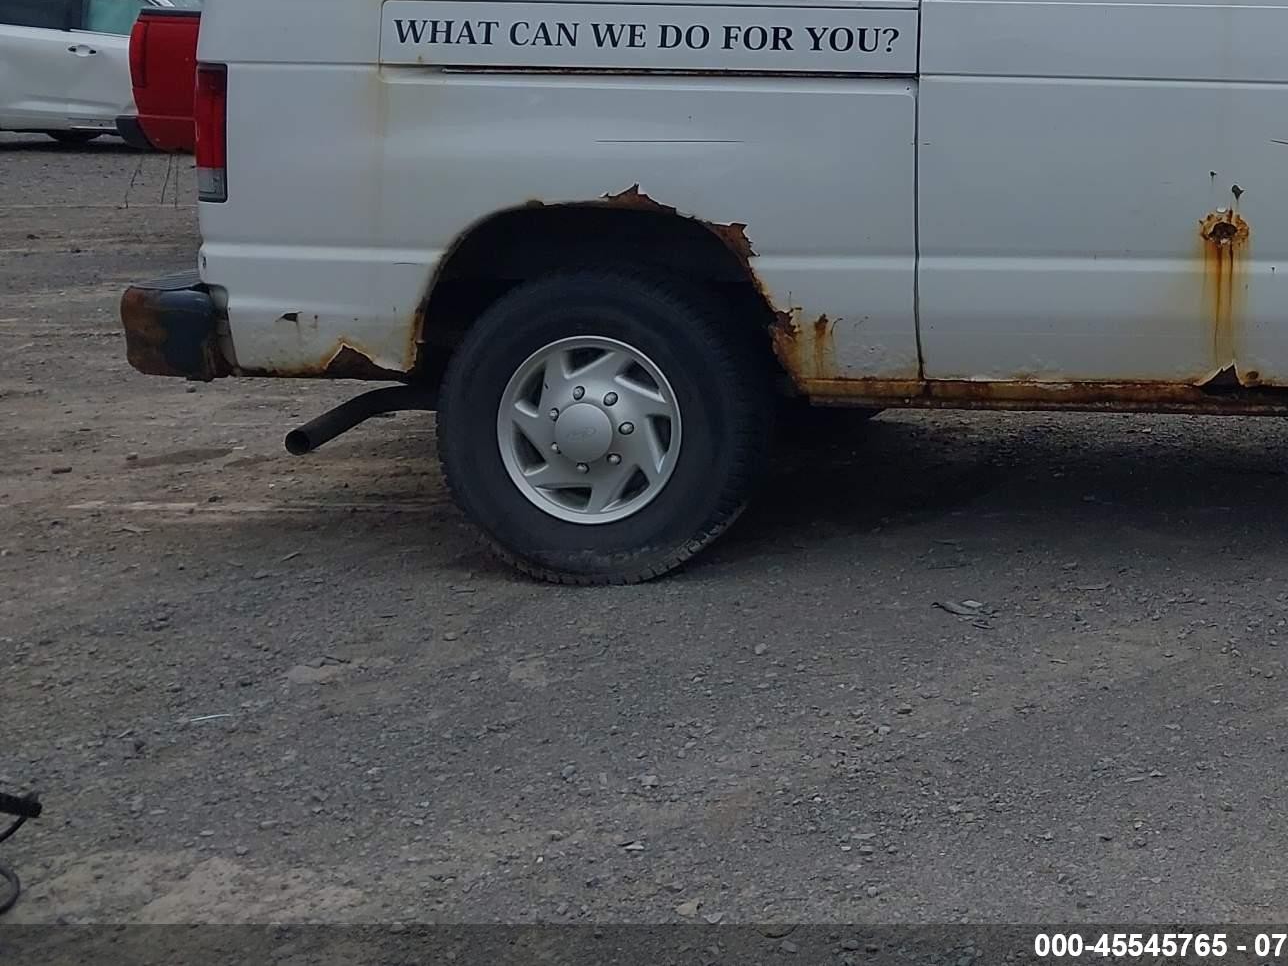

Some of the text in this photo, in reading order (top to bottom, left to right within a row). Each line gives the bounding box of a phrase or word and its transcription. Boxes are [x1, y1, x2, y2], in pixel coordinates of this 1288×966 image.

[393, 19, 900, 53] WHAT CAN WE DO FOR YOU?
